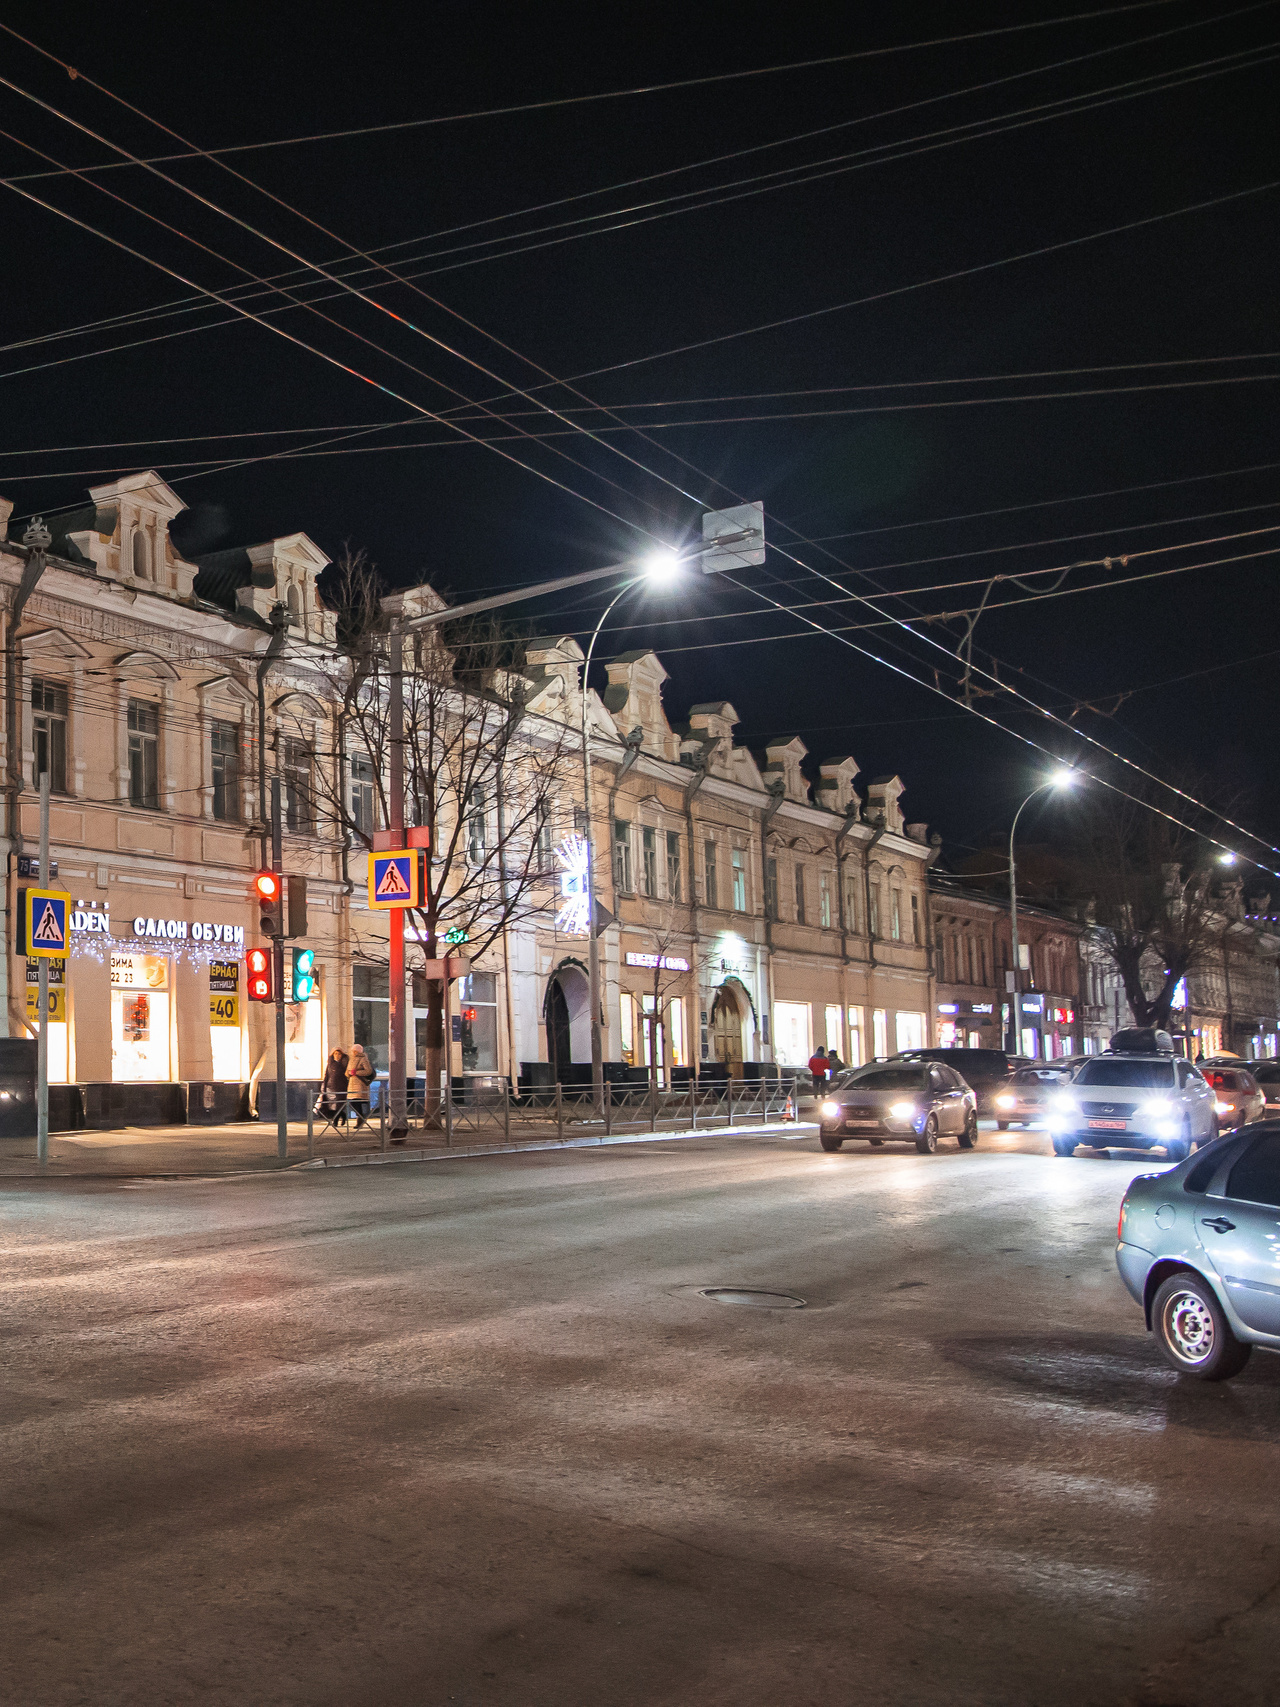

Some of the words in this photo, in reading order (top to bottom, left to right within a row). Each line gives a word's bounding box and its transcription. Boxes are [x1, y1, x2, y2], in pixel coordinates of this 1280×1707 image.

[20, 860, 29, 872] 75
[133, 917, 187, 939] САЛОН
[192, 922, 244, 943] ОБУВИ
[110, 957, 134, 969] ЗИМА
